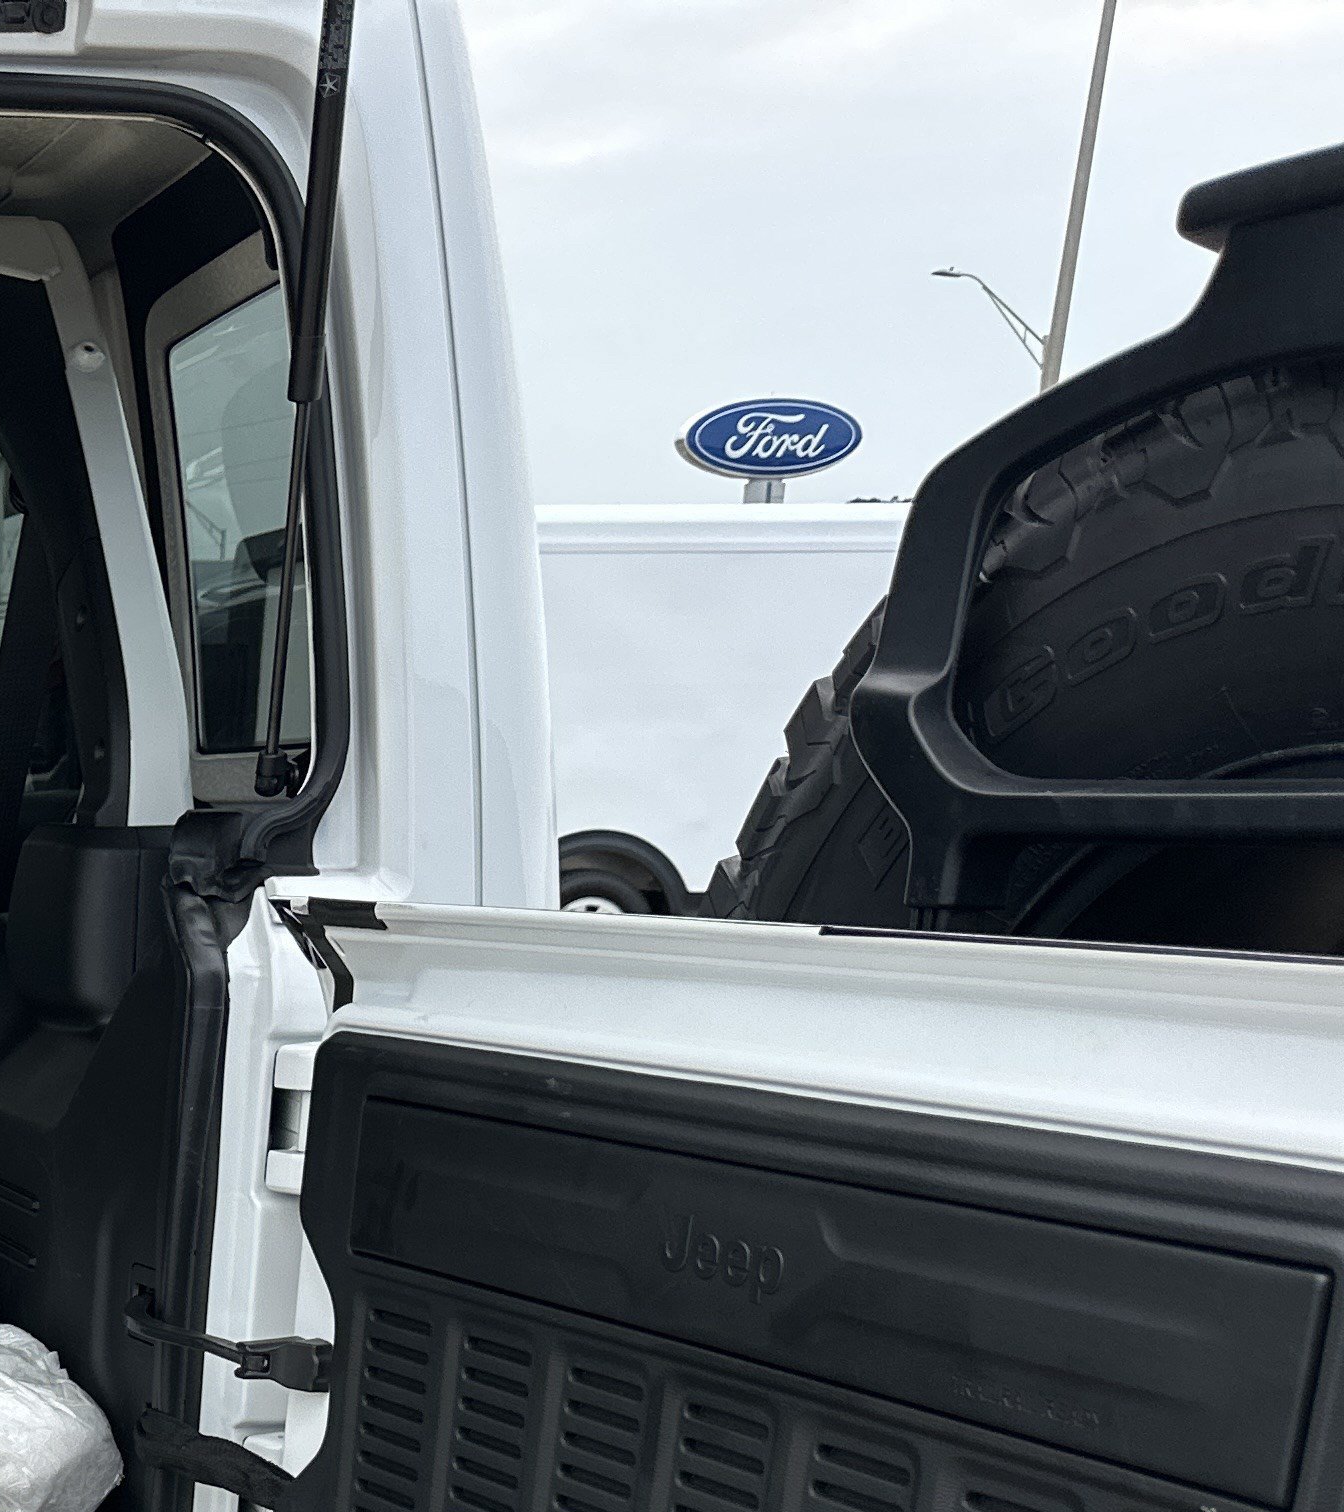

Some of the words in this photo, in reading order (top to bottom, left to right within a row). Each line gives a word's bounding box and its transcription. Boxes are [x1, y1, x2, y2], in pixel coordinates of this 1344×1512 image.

[724, 412, 830, 459] Ford
[983, 534, 1344, 738] Good
[664, 1214, 785, 1306] Jeep
